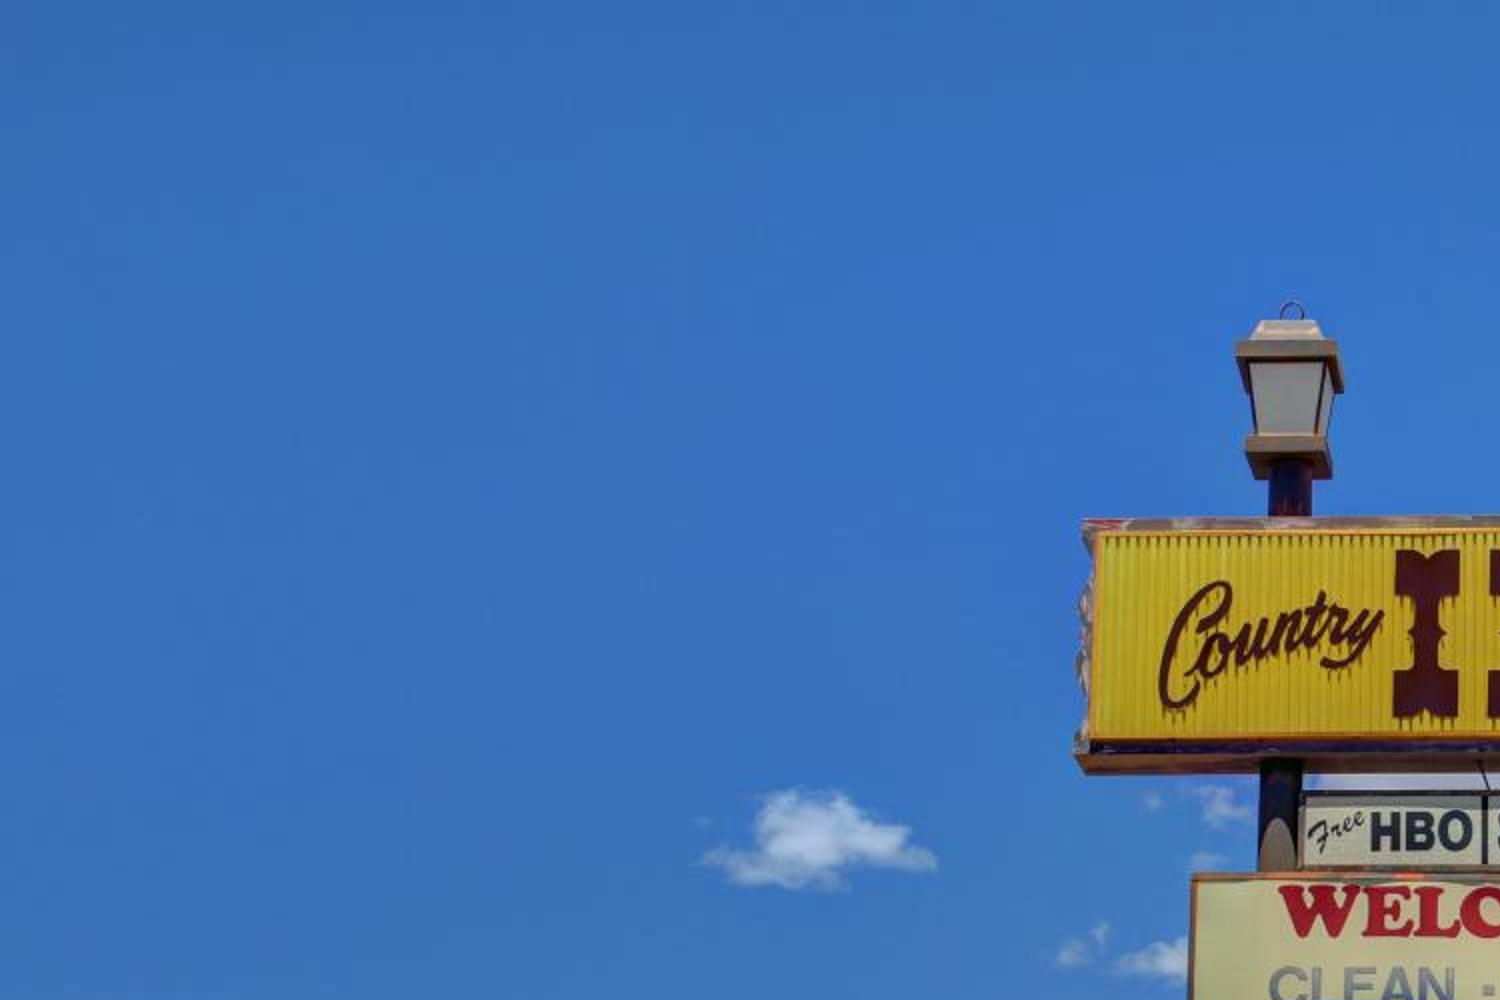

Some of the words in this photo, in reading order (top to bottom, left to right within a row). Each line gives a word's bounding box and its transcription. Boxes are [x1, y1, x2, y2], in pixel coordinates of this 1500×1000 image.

[1158, 579, 1384, 710] Country
[1307, 811, 1366, 854] Free
[1370, 809, 1473, 853] HBO
